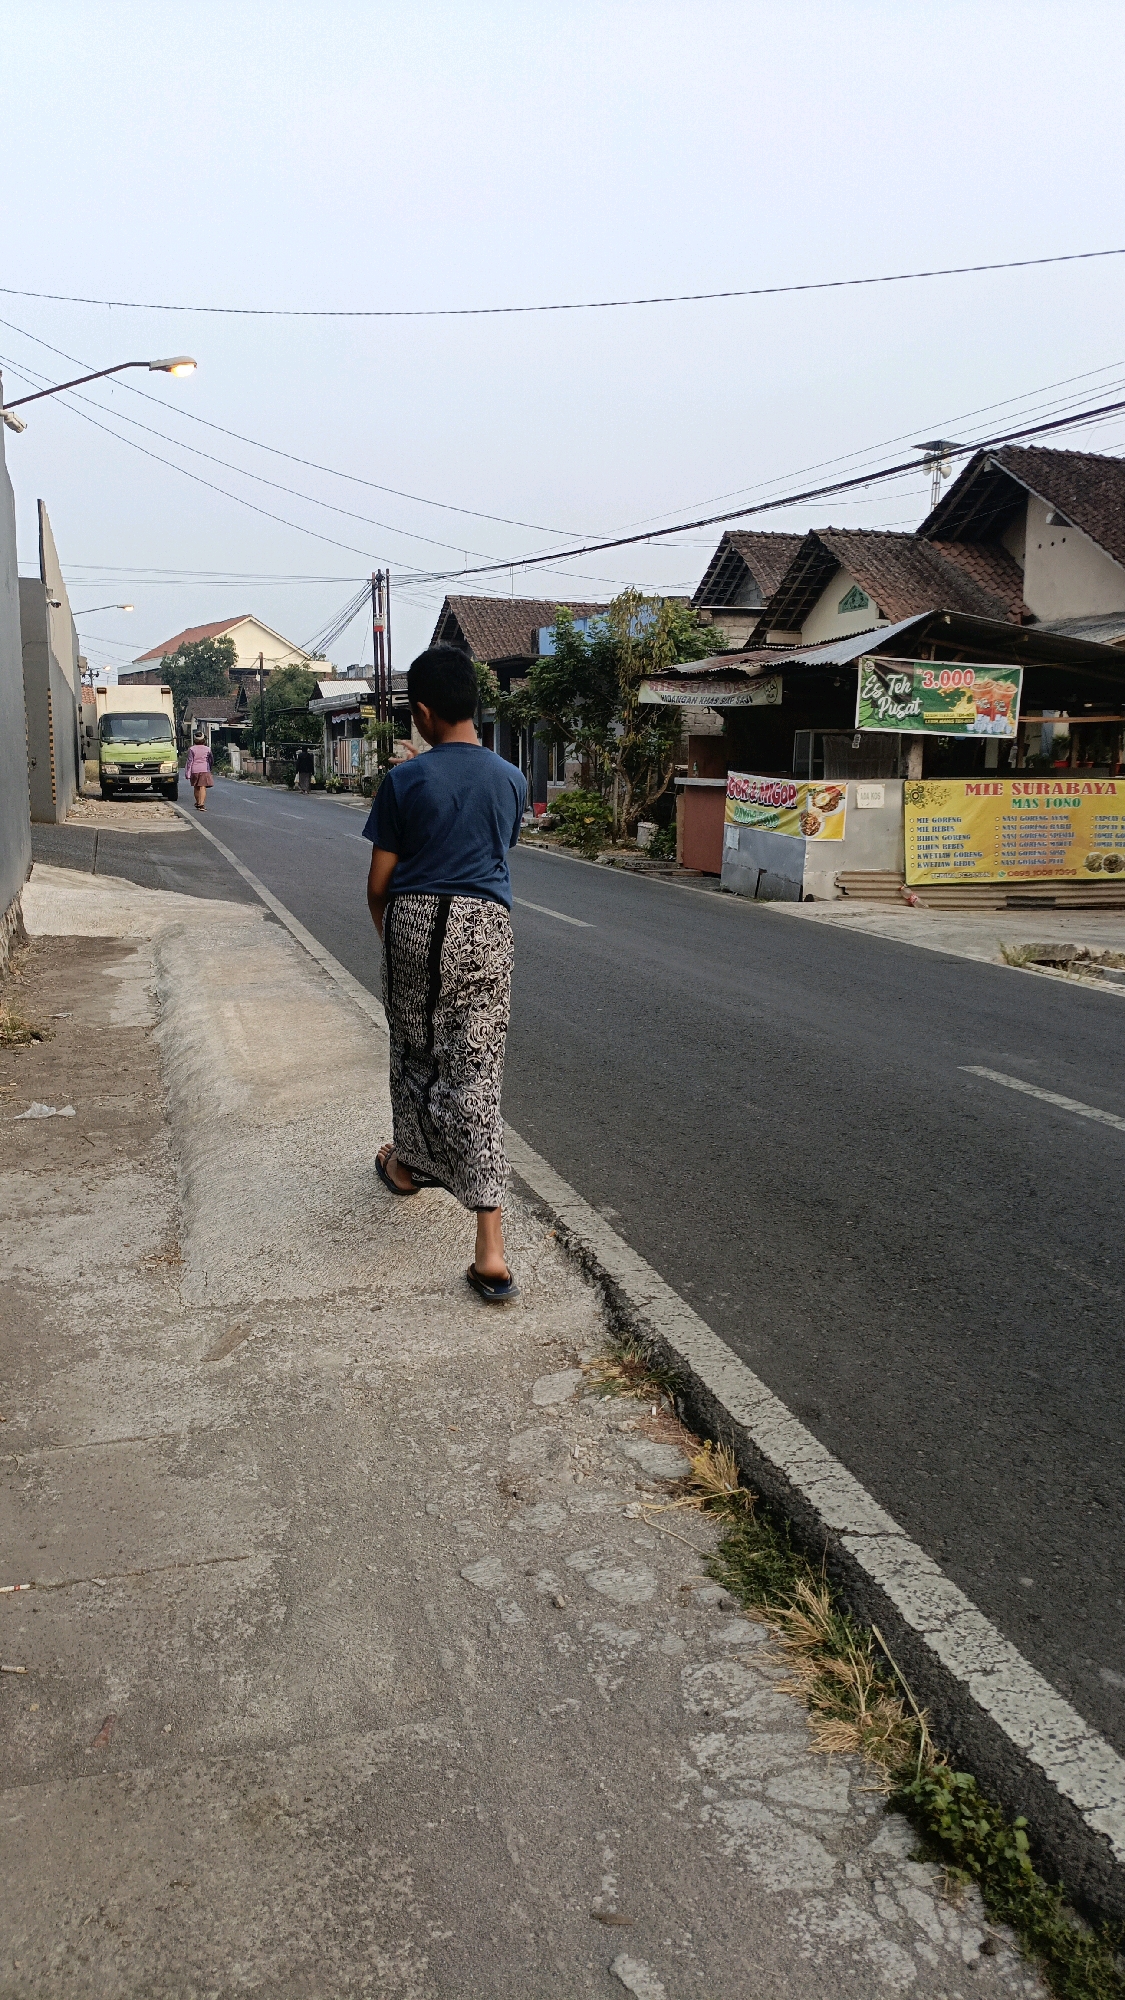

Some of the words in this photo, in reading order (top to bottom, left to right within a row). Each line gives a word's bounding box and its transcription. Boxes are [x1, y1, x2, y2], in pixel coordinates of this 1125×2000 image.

[922, 669, 975, 688] 3.000
[862, 675, 884, 699] Es
[887, 674, 912, 696] Teh
[699, 696, 720, 705] KHAS
[878, 697, 923, 719] Pusat
[860, 792, 870, 800] ADA
[871, 791, 881, 800] KOS
[965, 783, 1003, 796] MIE
[1011, 783, 1117, 796] SURABAYA
[1011, 798, 1039, 809] MAS
[1045, 798, 1082, 809] TONO
